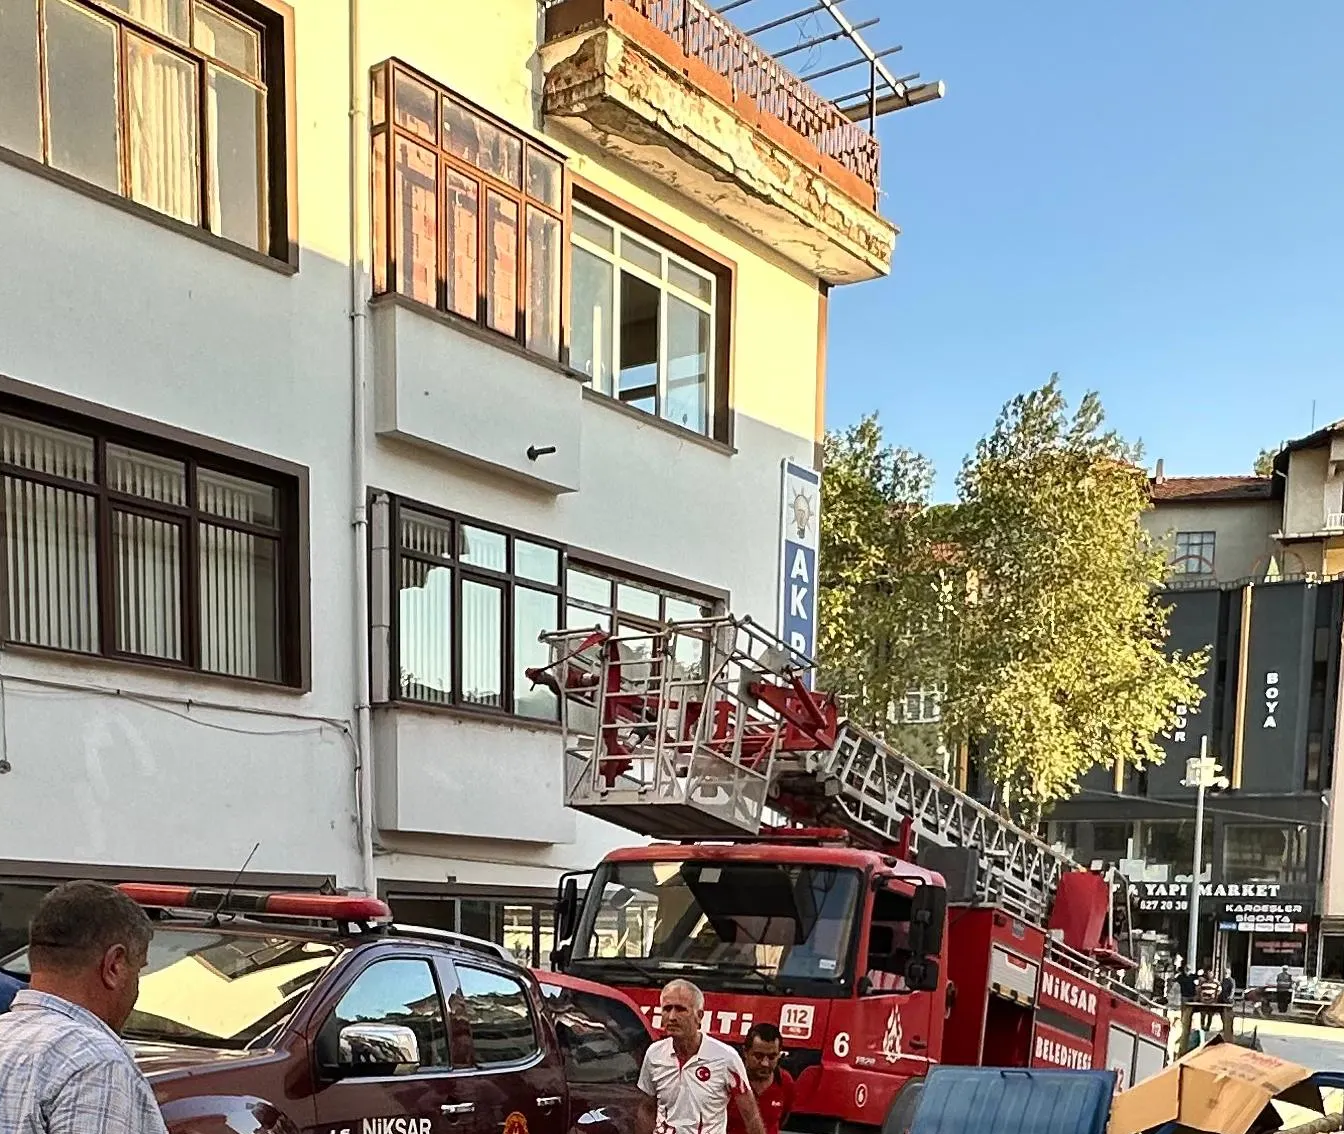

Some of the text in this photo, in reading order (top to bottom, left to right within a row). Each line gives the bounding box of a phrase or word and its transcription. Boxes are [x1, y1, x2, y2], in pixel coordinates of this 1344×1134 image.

[1263, 672, 1279, 728] BOYA
[1145, 884, 1188, 897] YAPI
[1199, 884, 1281, 897] MARKET
[786, 1008, 808, 1025] 112
[833, 1032, 850, 1058] 6
